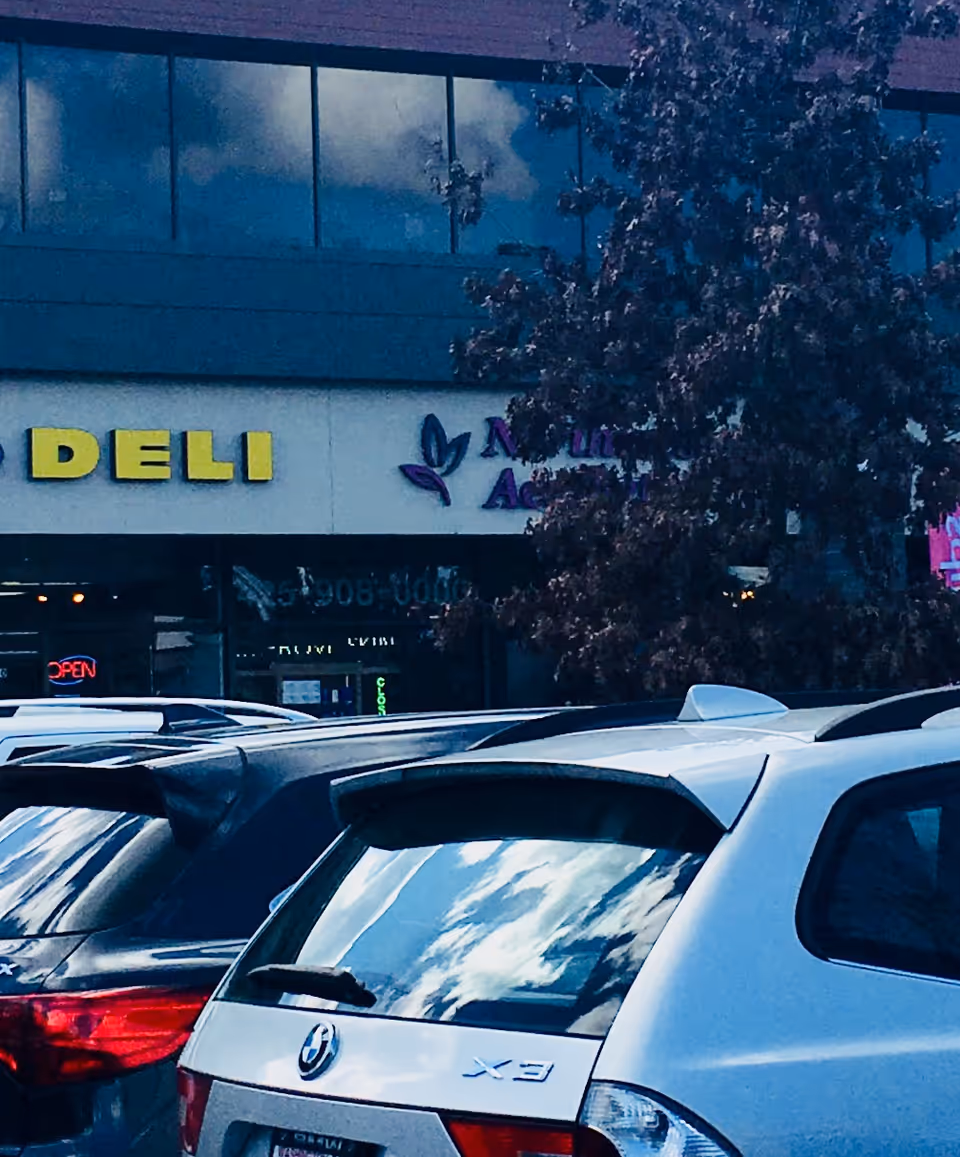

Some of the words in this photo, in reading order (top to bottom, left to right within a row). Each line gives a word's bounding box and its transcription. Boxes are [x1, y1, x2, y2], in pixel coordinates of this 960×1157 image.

[27, 428, 273, 481] DELI
[47, 661, 96, 679] OPEN
[462, 1056, 554, 1083] X3
